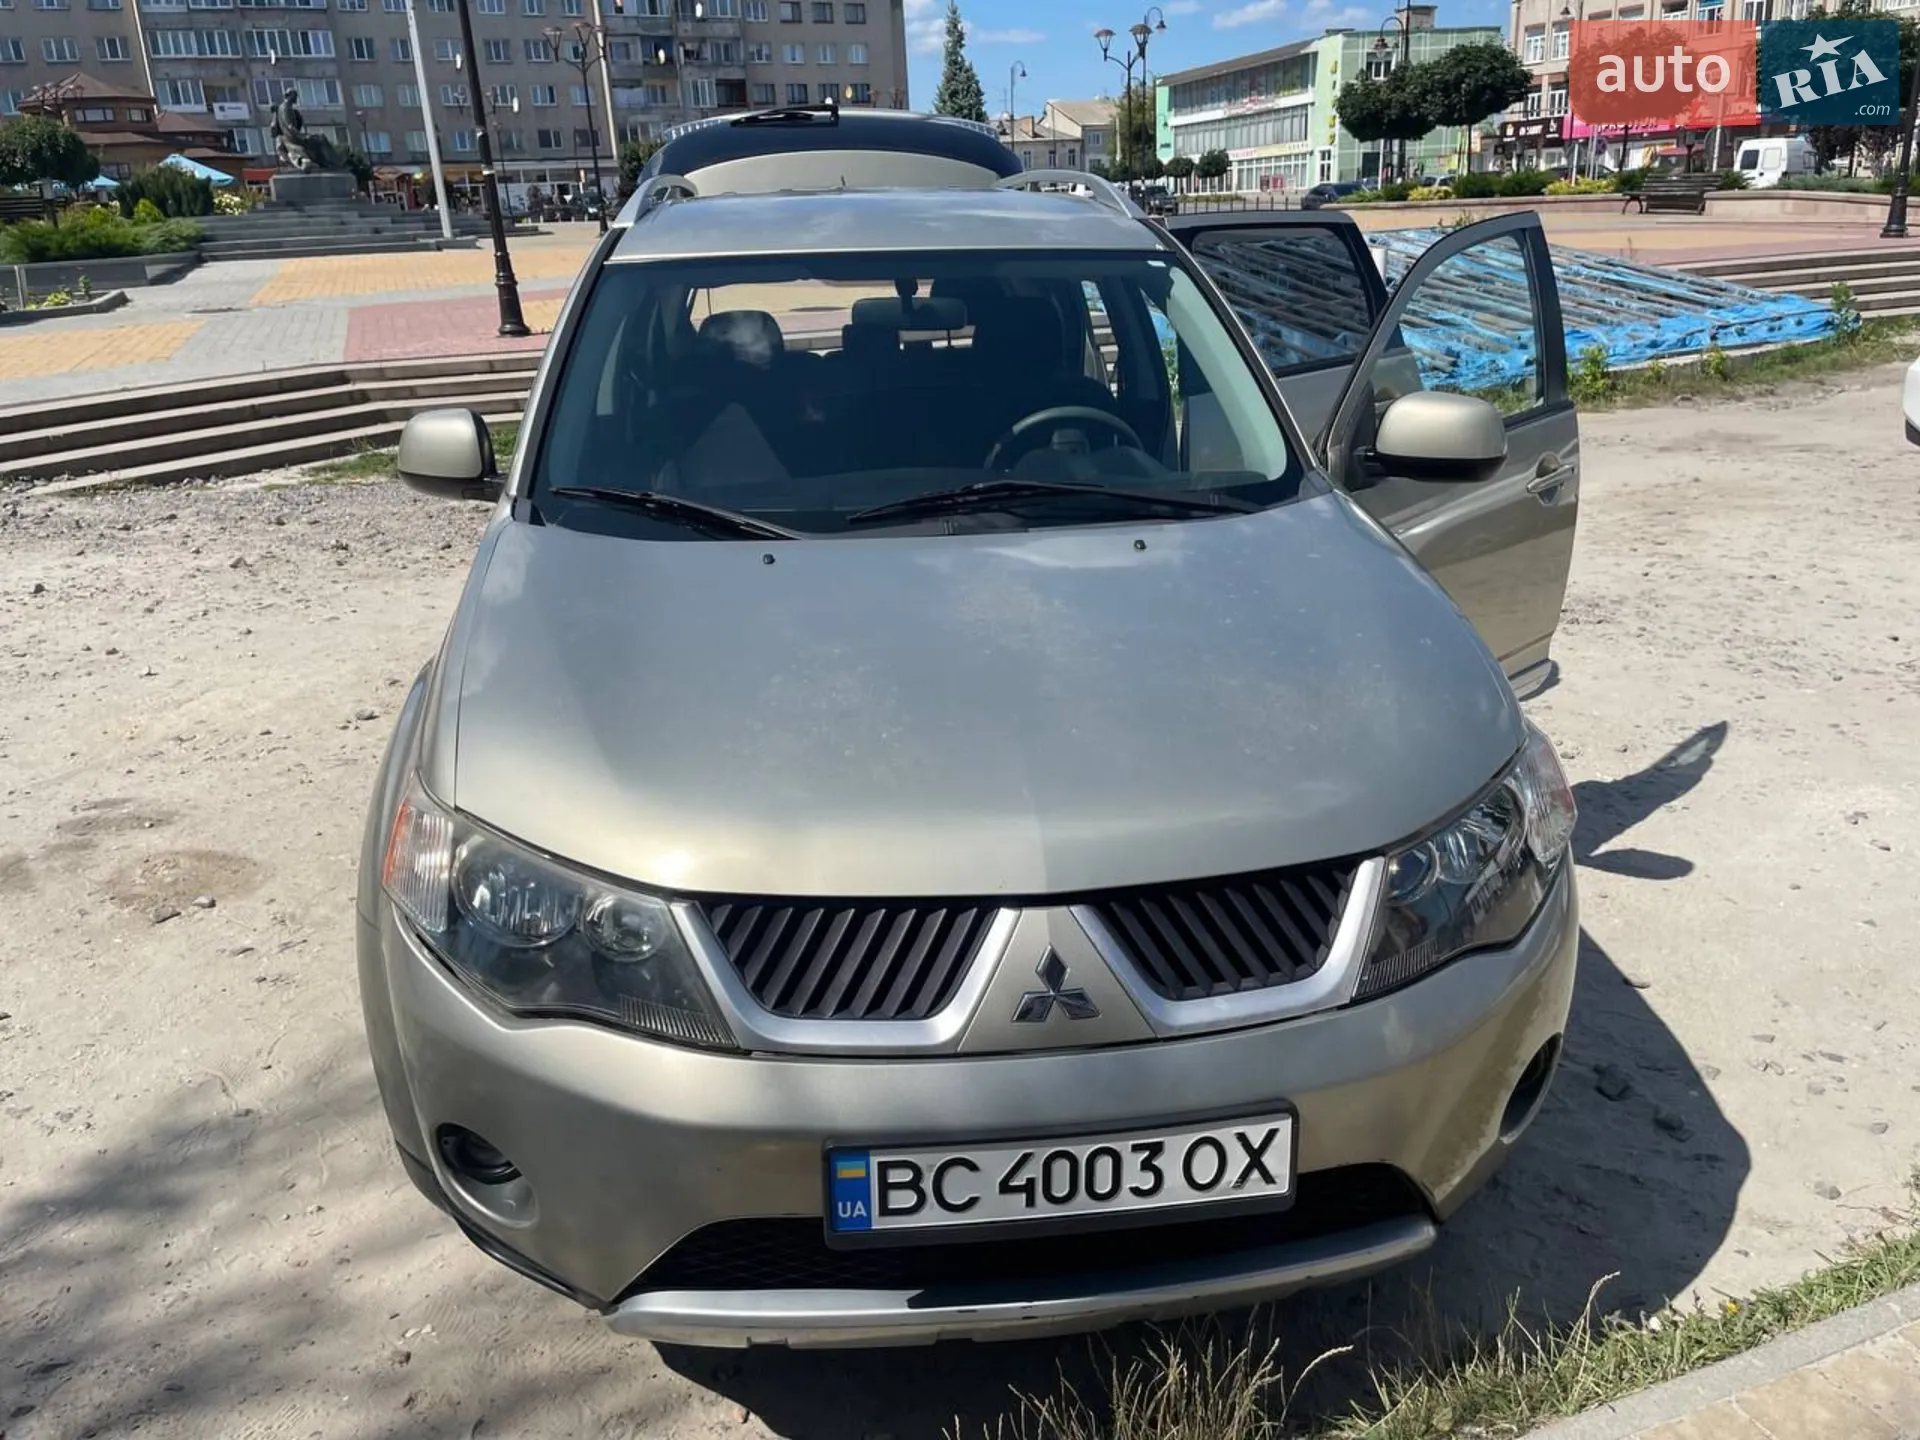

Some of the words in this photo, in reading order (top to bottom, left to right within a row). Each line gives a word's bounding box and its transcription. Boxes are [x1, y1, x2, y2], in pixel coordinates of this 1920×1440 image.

[877, 1156, 981, 1217] BC
[998, 1140, 1164, 1208] 4003
[1182, 1127, 1280, 1192] OX
[838, 1200, 867, 1218] UA
